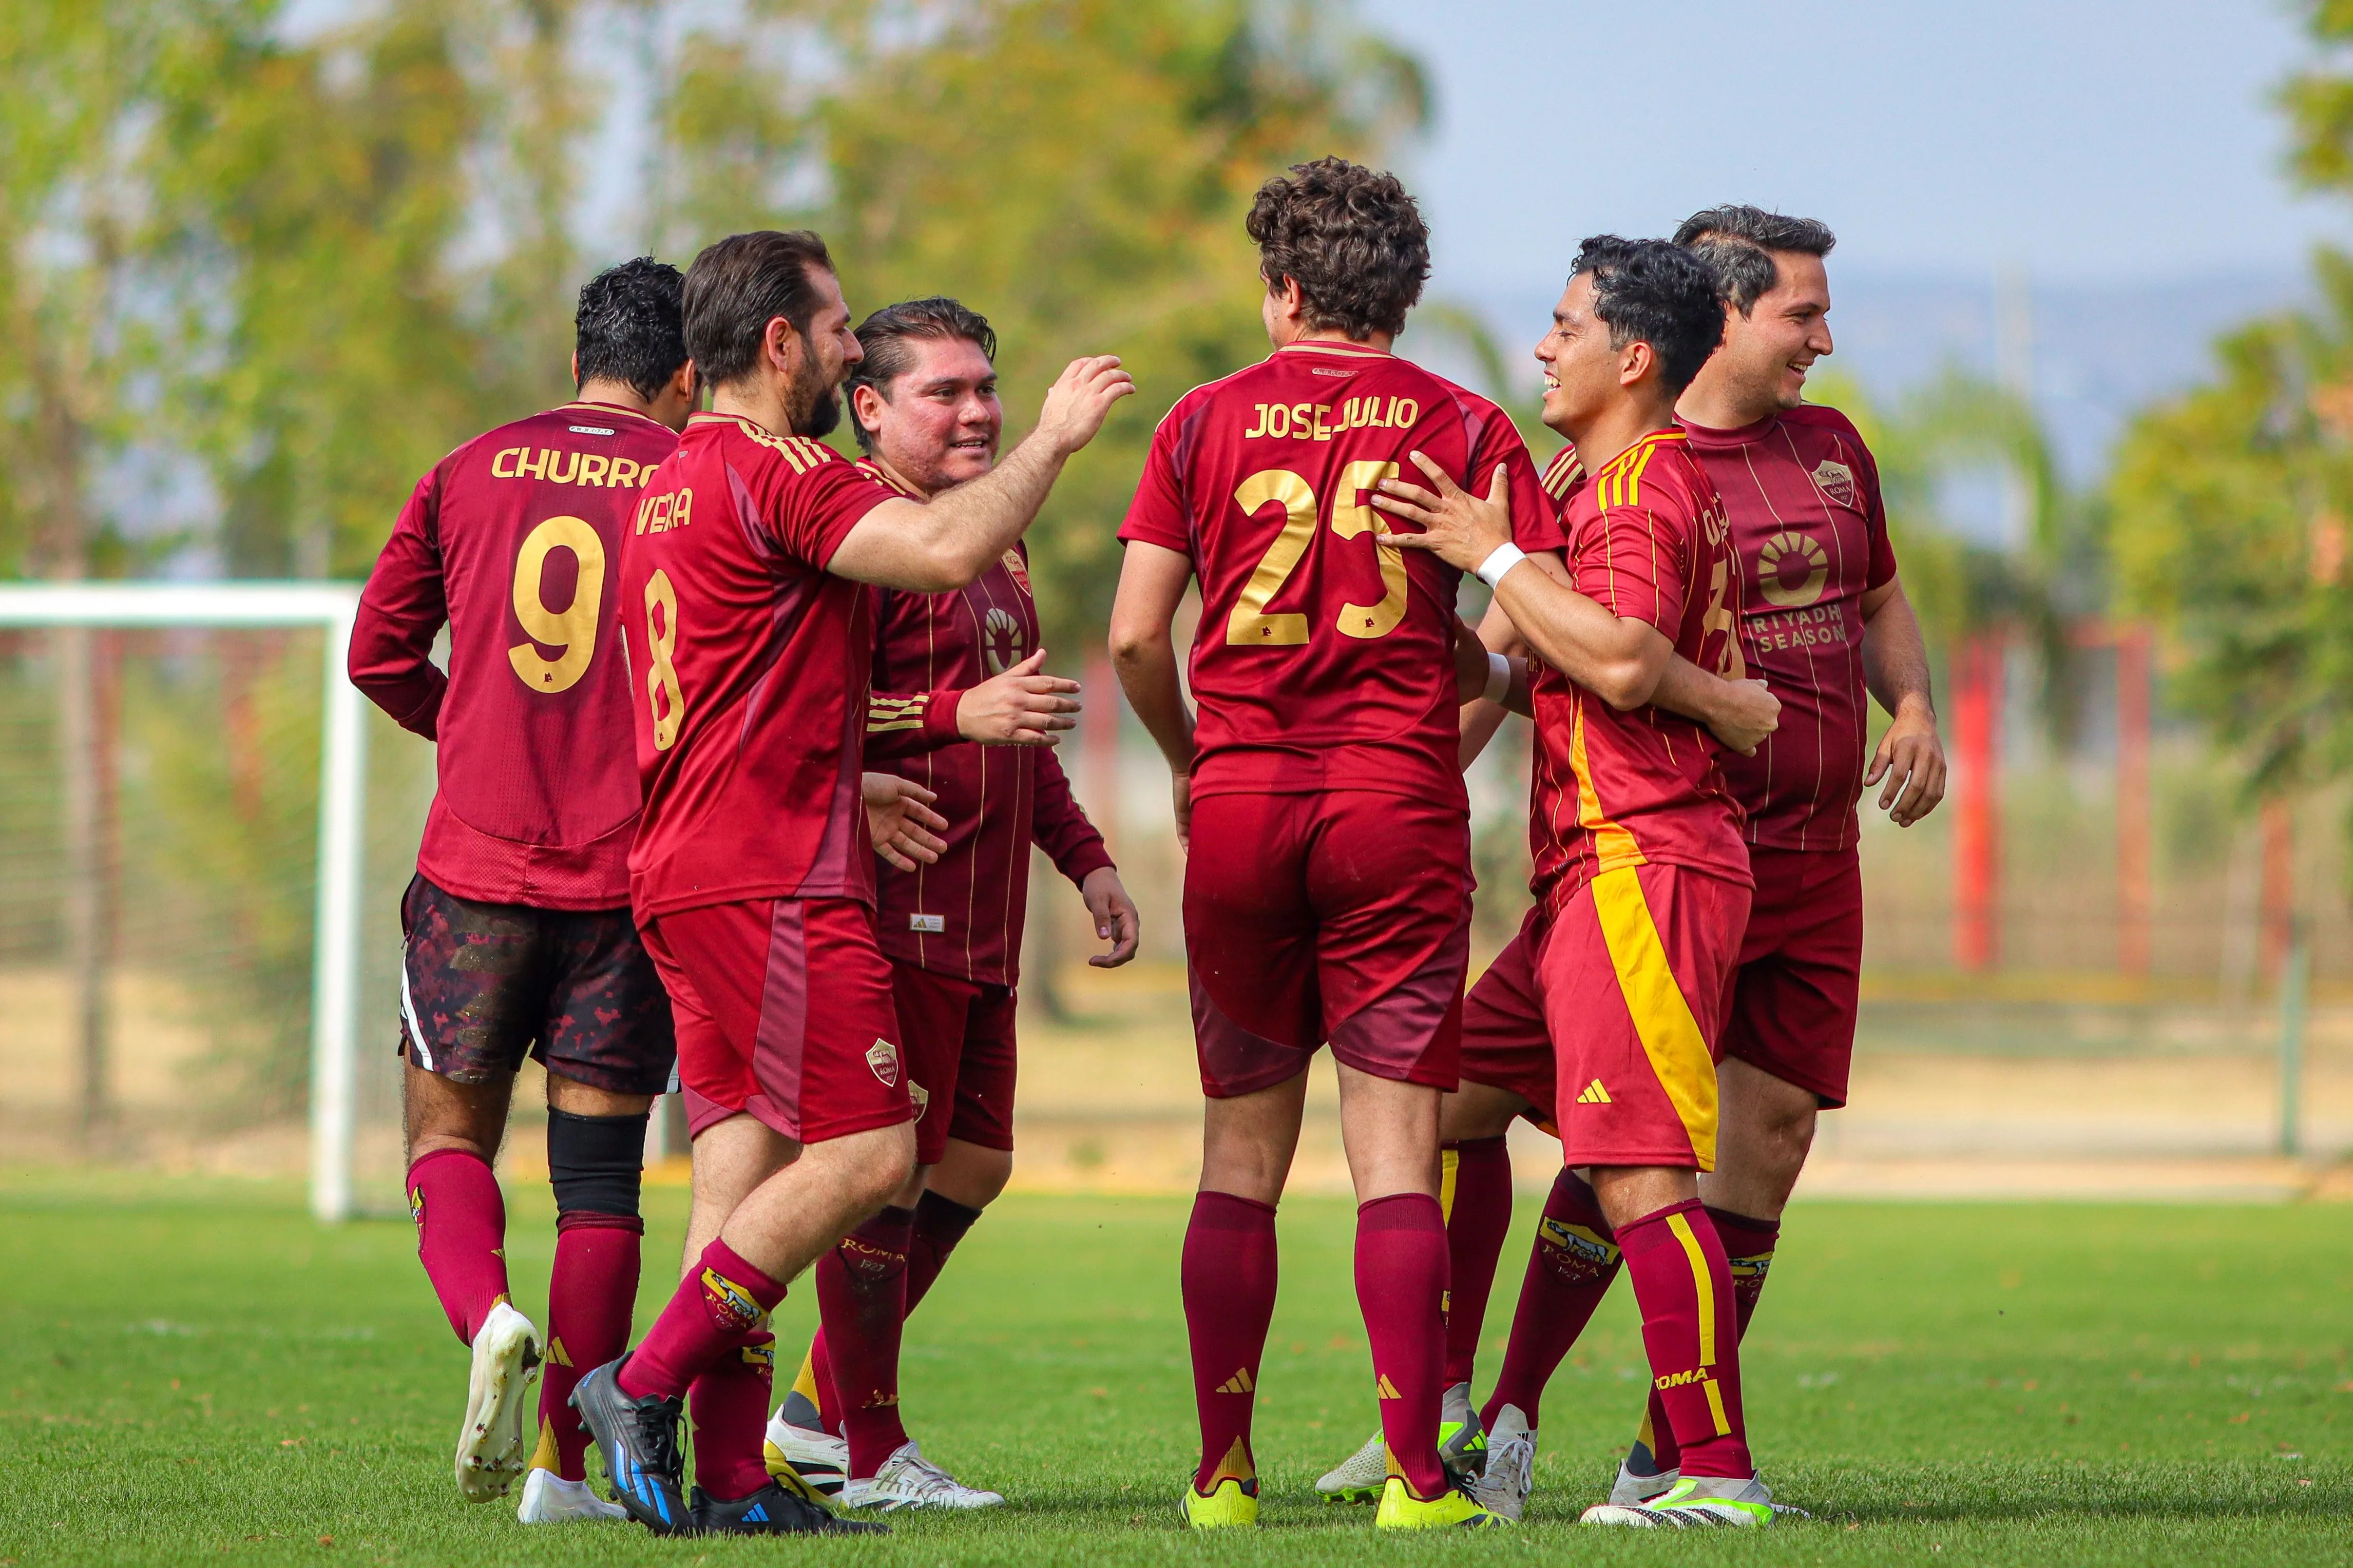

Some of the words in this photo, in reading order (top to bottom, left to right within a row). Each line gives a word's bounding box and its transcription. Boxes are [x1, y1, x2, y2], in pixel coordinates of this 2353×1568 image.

[1829, 486, 1851, 495] ROMA
[636, 487, 693, 536] VERA
[1227, 460, 1408, 645] 25
[508, 516, 605, 693] 9
[1752, 604, 1841, 633] RIYADH
[1759, 624, 1846, 652] SEASON
[644, 568, 685, 751] 8
[879, 1066, 895, 1075] ROMA
[1542, 1244, 1599, 1277] ROMA
[705, 1292, 747, 1329] ROMA
[1655, 1367, 1709, 1390] OMA
